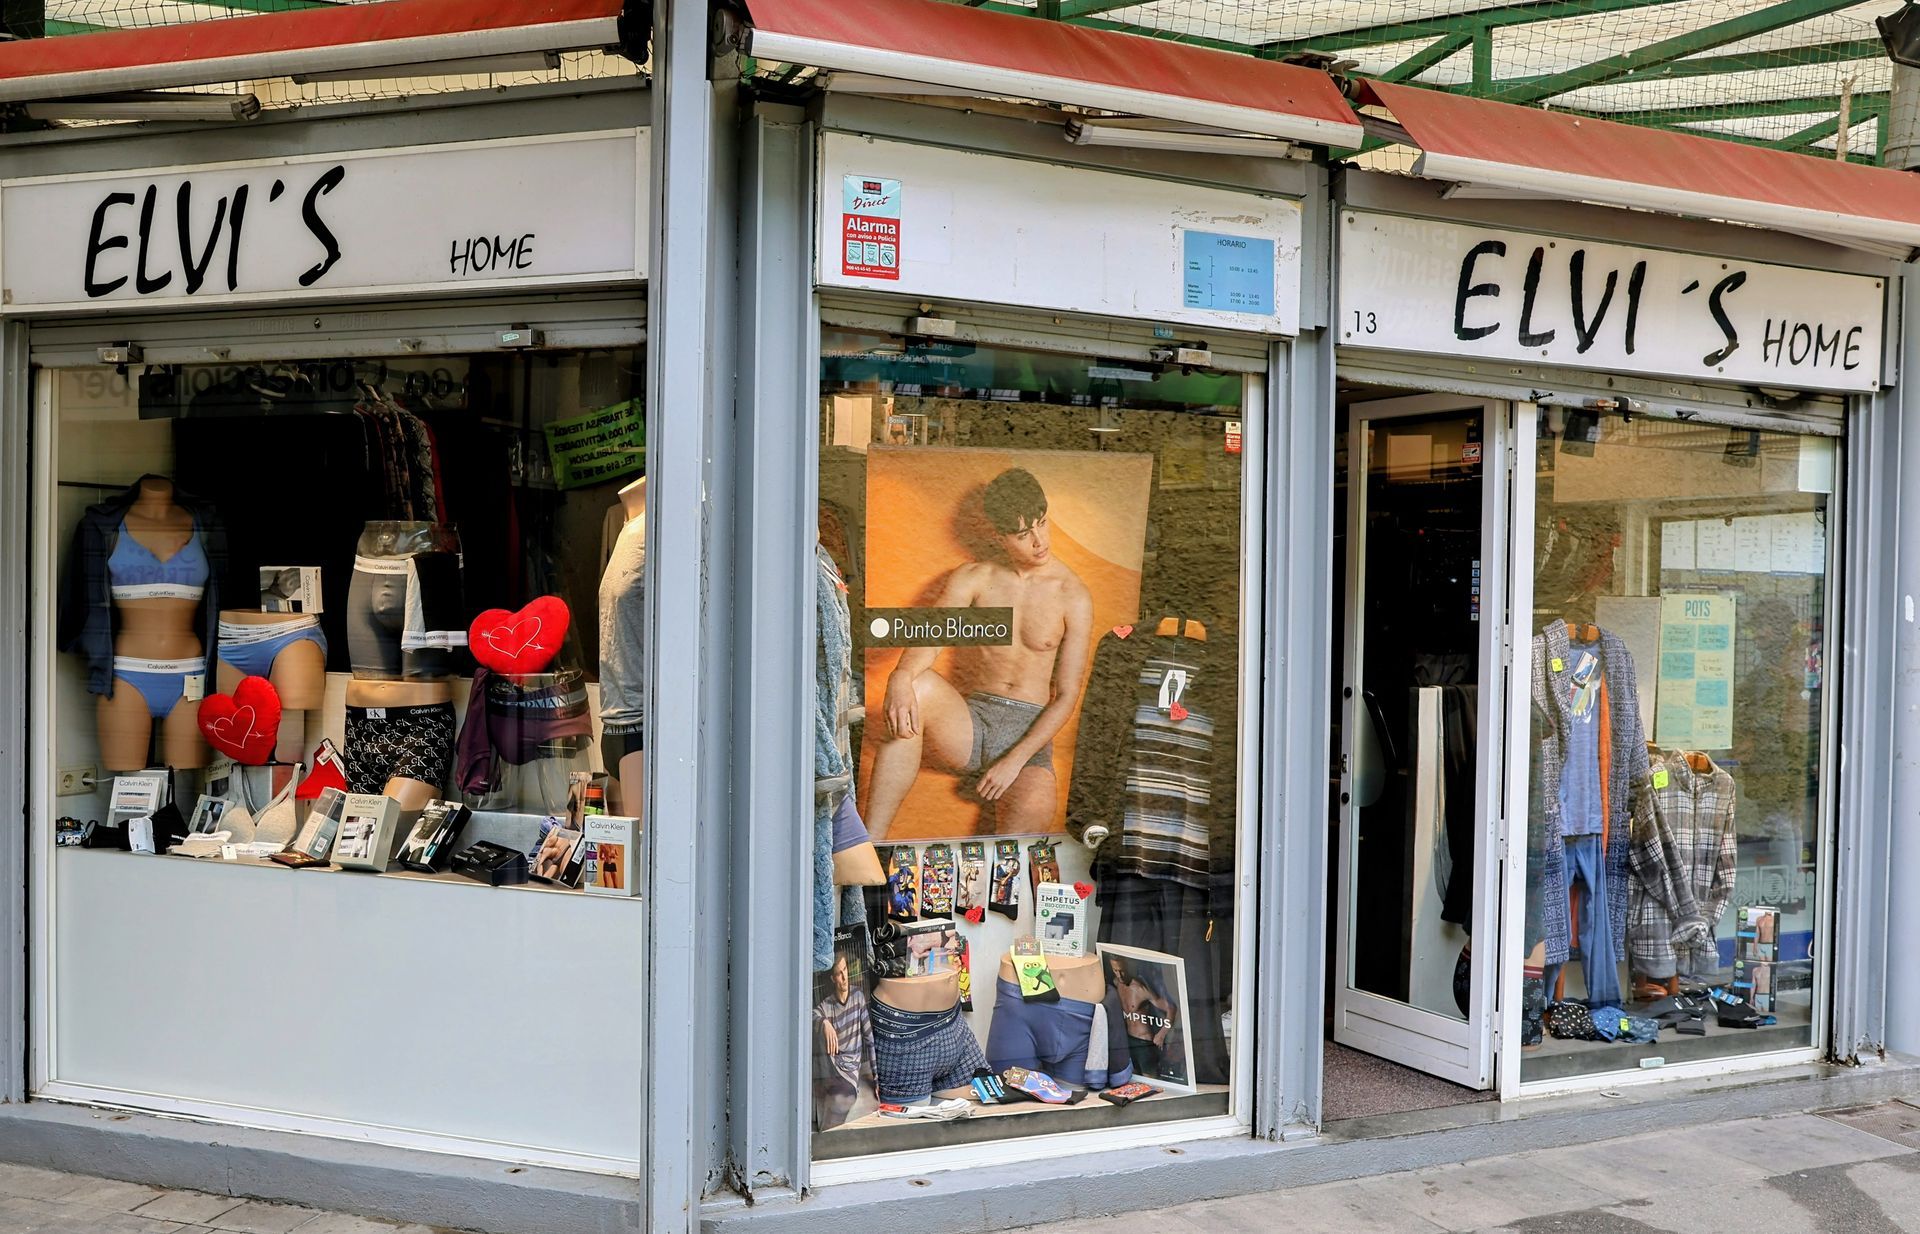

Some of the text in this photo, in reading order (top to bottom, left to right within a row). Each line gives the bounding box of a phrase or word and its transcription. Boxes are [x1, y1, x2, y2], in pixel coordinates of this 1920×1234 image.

[852, 195, 891, 210] Direct
[846, 217, 896, 235] Alarma
[857, 233, 873, 241] aviso
[1216, 239, 1247, 249] HORARIO
[450, 232, 536, 275] HOME
[1354, 310, 1377, 334] 13
[1762, 317, 1863, 371] HOME
[1684, 600, 1711, 617] POTS
[894, 615, 1008, 639] Punto Blanco
[409, 707, 430, 716] Calvin
[349, 797, 383, 806] Calvin Klein
[590, 821, 626, 831] Calvin Klein
[1041, 895, 1080, 905] IMPETUS
[1071, 941, 1078, 950] S
[1123, 1011, 1172, 1029] MPETUS
